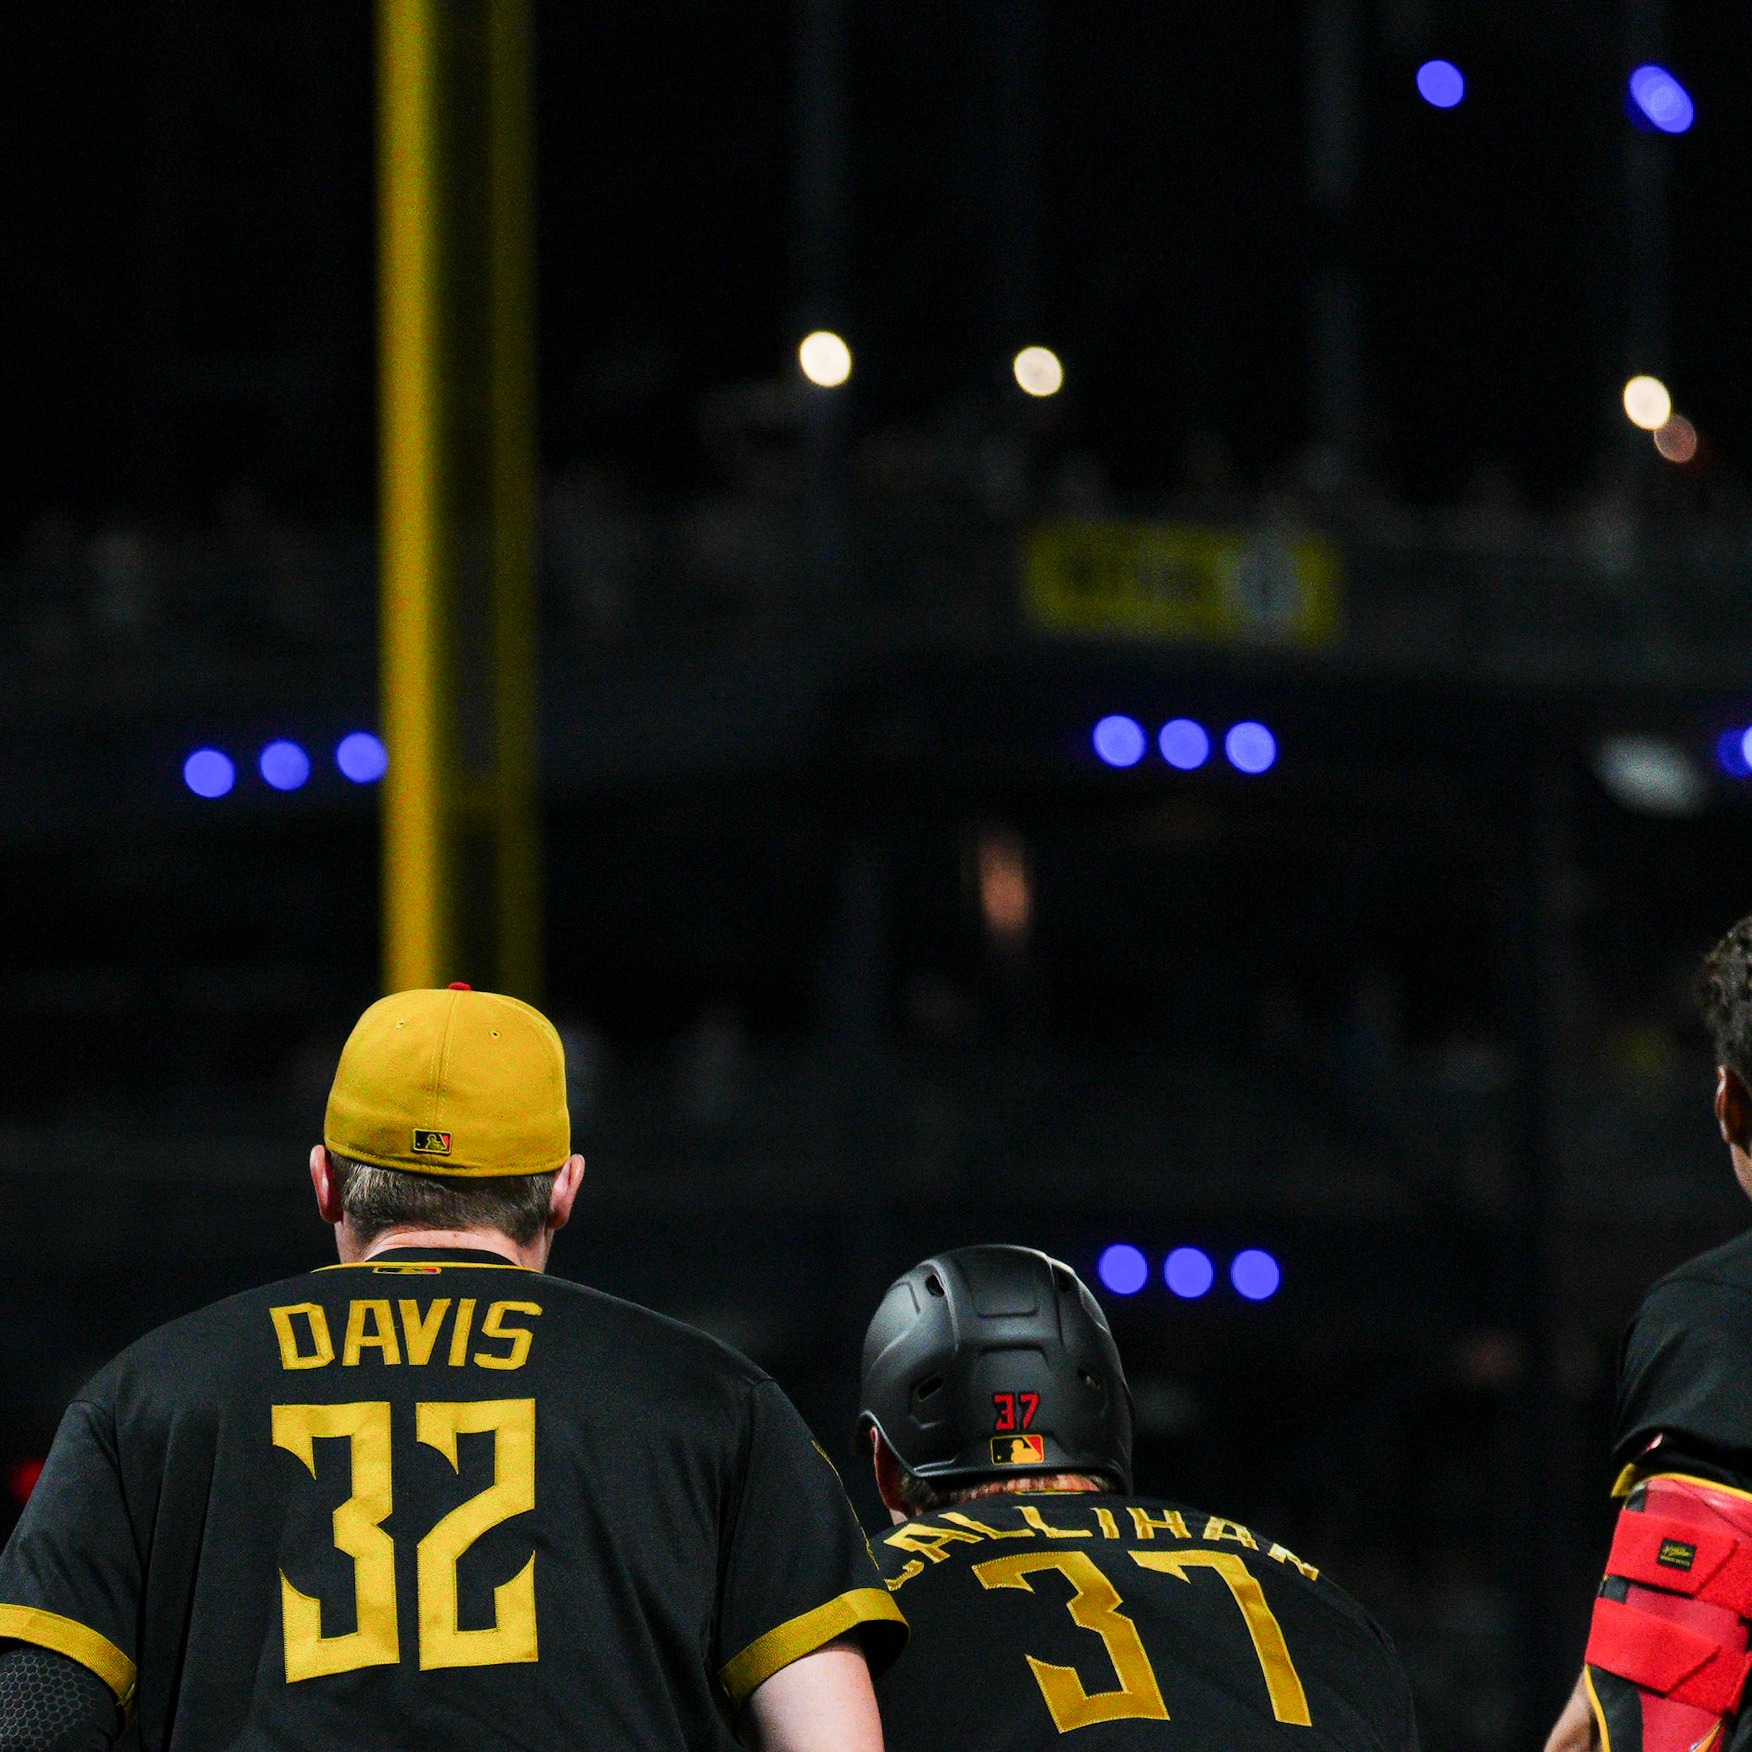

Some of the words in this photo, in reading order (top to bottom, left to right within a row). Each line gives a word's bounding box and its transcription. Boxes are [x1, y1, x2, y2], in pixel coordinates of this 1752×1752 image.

[269, 1298, 543, 1371] DAVIS
[993, 1392, 1040, 1431] 37
[271, 1398, 539, 1684] 32
[972, 1549, 1313, 1735] 37
